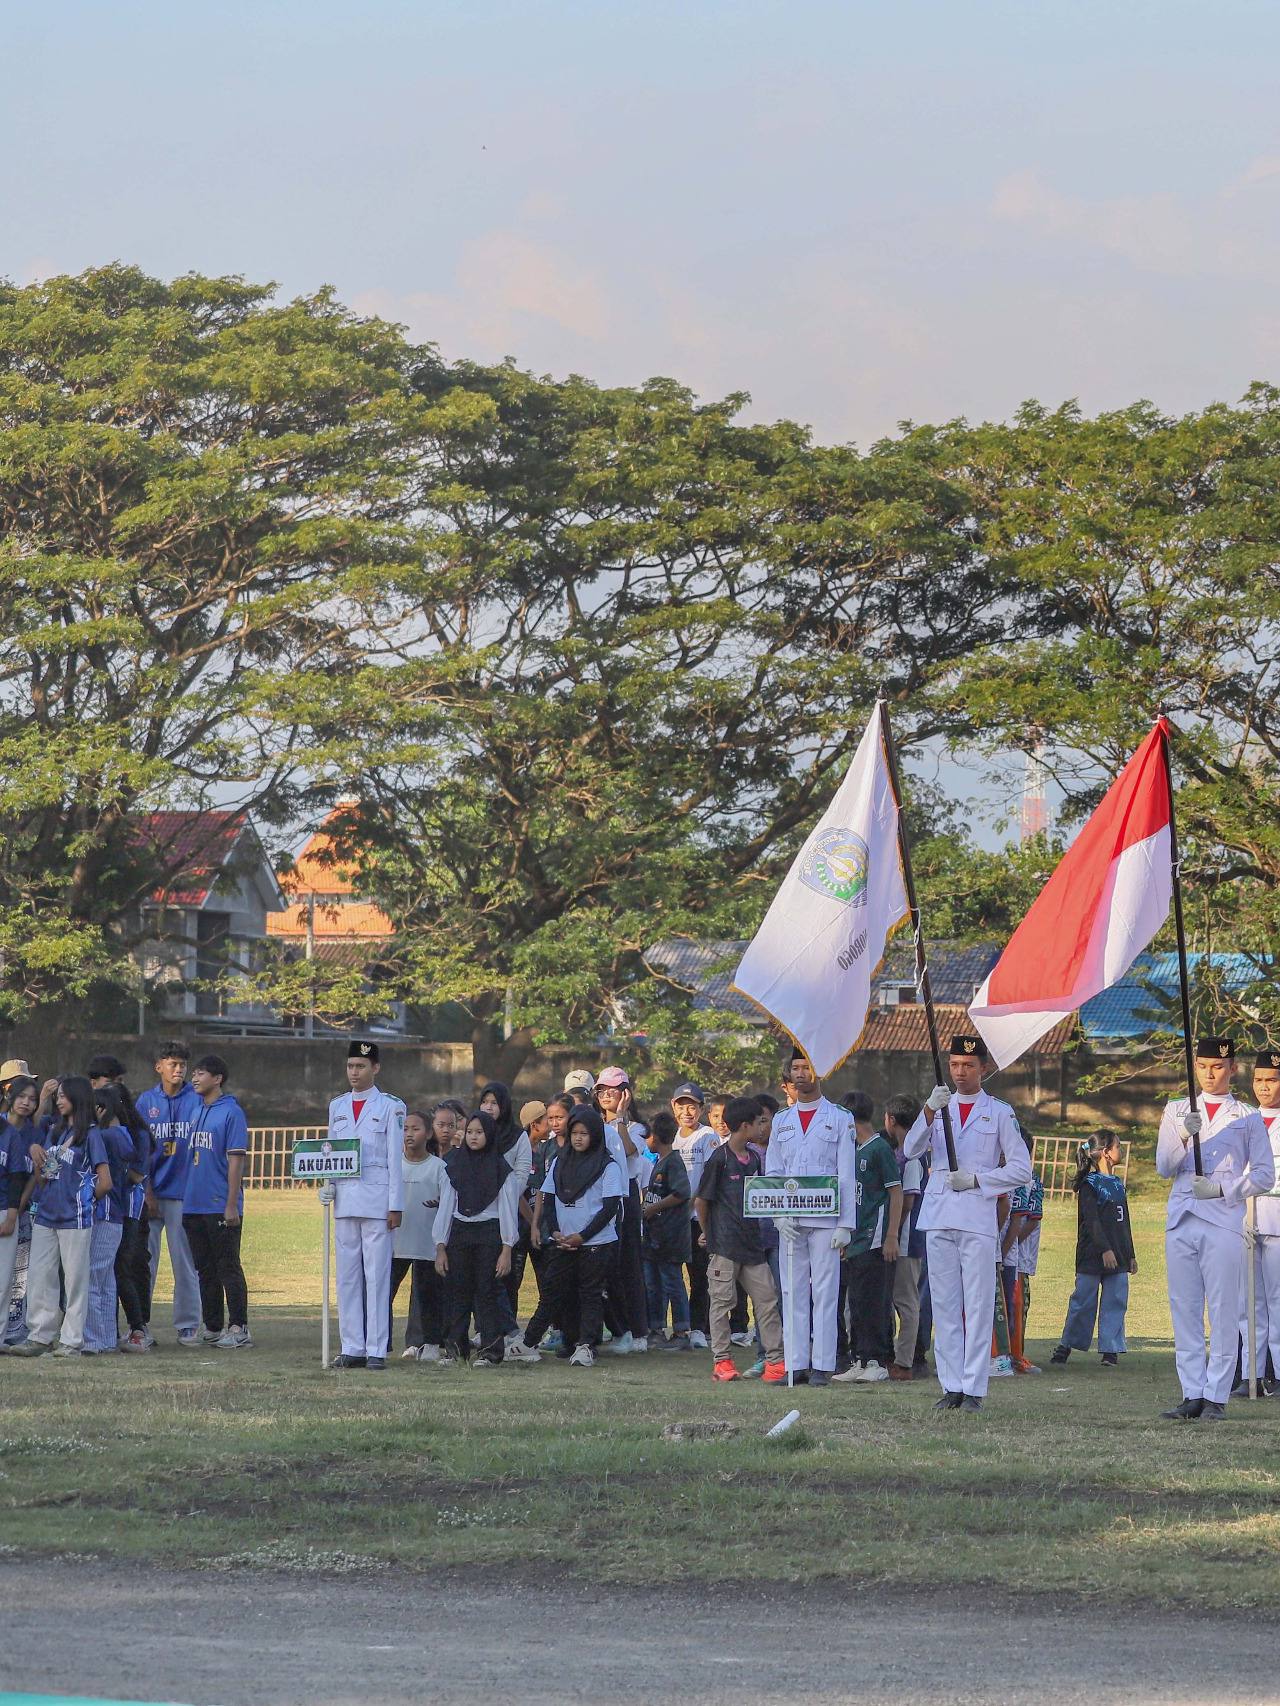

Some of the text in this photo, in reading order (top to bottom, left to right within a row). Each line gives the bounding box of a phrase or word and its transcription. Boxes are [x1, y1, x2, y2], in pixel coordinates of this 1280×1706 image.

[298, 1157, 353, 1172] AKUATIK
[751, 1195, 831, 1208] SEPAK TAKRAW
